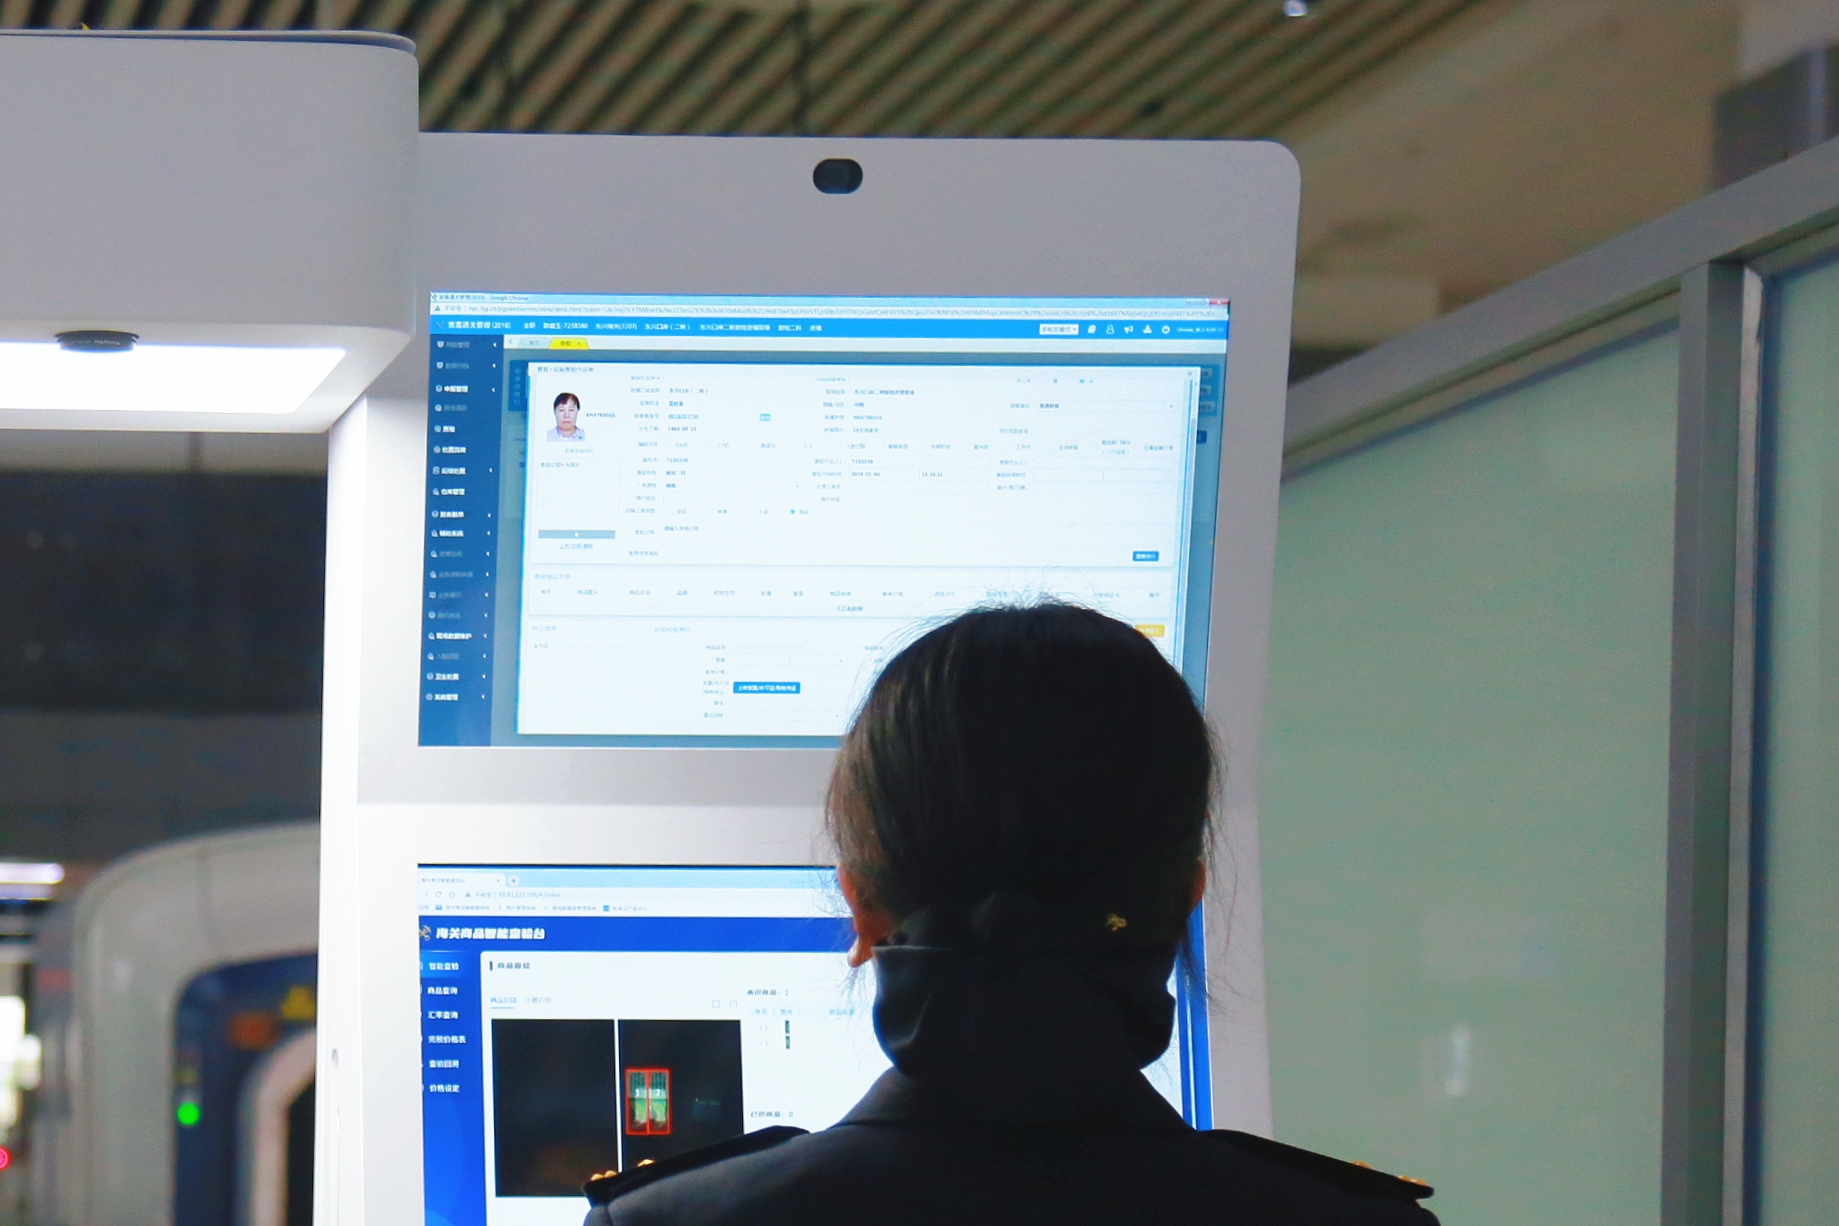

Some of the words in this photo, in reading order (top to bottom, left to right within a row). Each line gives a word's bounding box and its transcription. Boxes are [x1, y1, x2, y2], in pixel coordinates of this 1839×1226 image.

[436, 927, 546, 940] 海关商品智能查验台
[429, 962, 459, 971] 智能查验
[427, 986, 458, 995] 商品查询
[428, 1011, 459, 1020] 汇率查询
[429, 1084, 460, 1093] 价格设定
